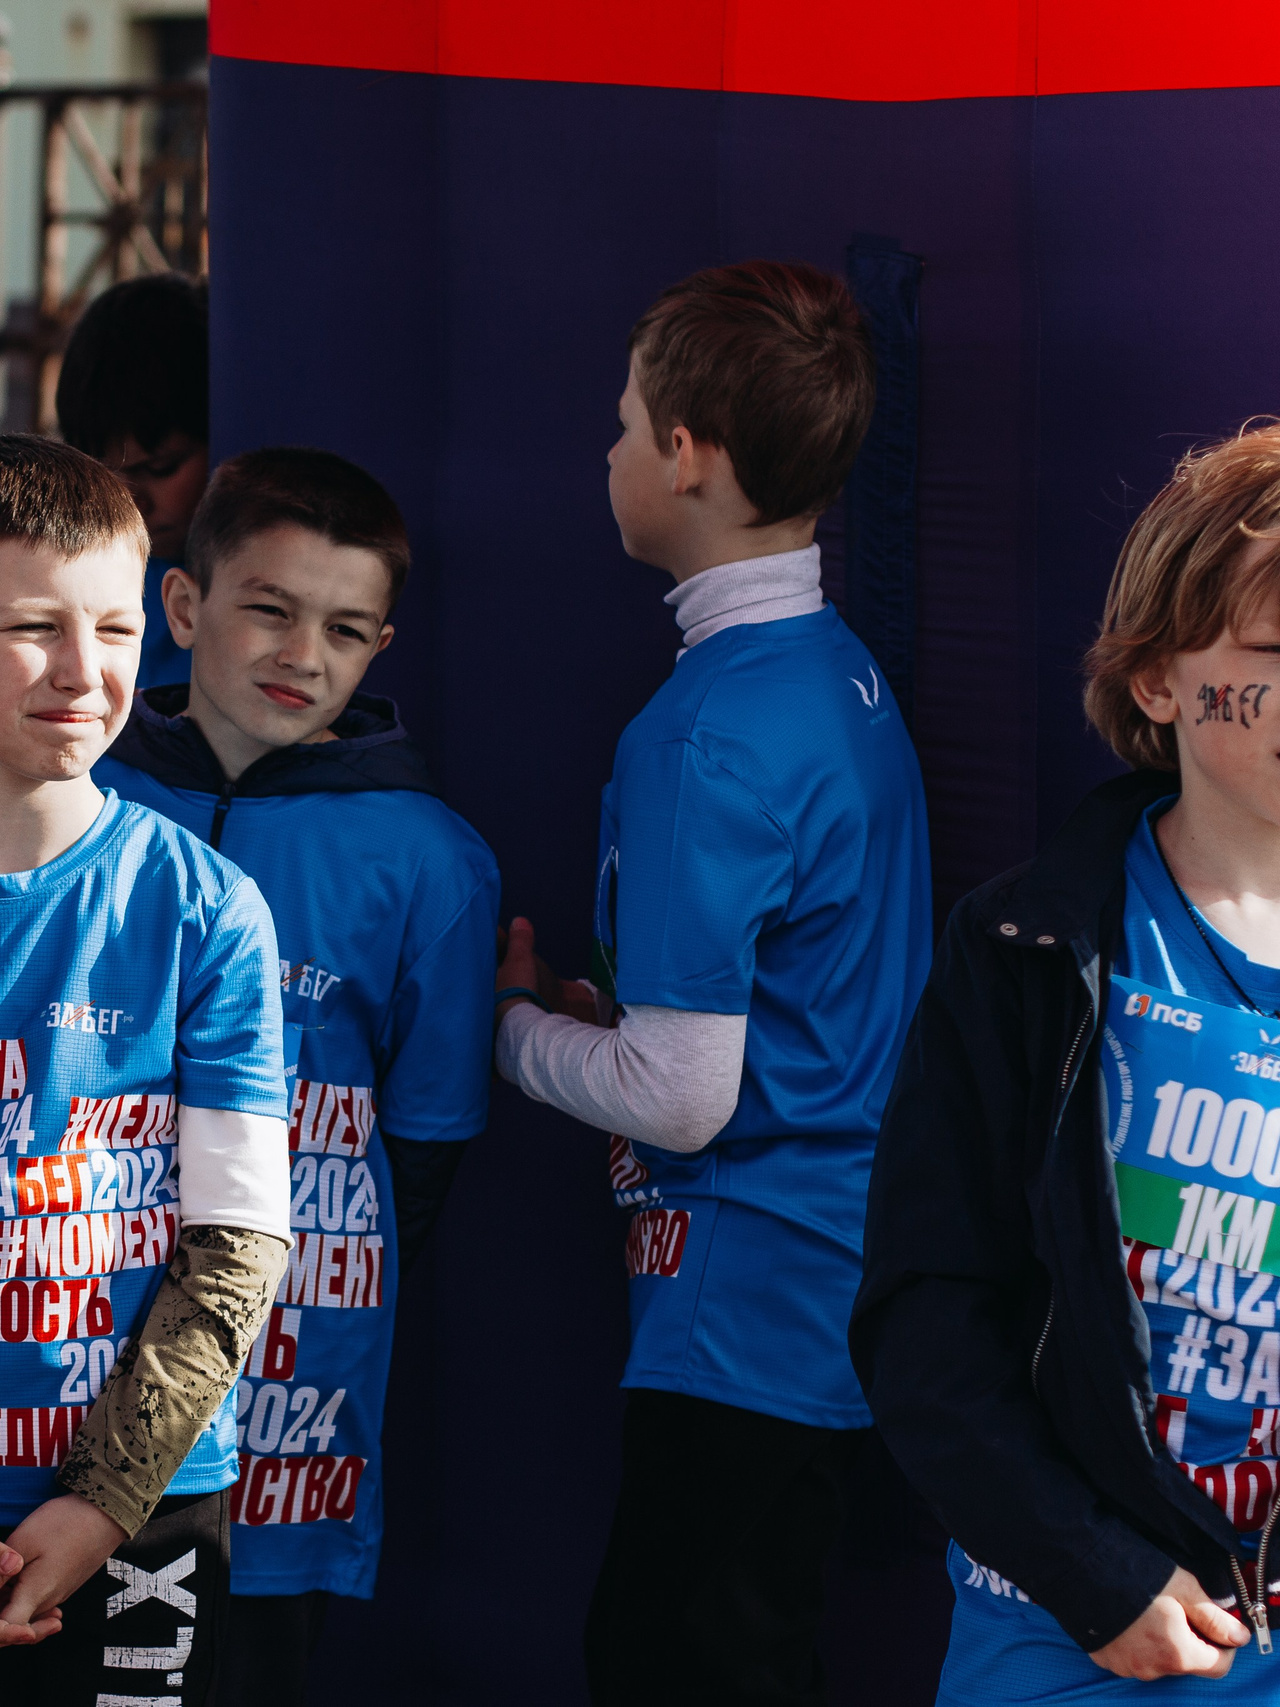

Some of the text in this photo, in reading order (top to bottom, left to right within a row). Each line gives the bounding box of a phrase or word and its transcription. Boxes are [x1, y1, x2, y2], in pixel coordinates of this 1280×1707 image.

[1151, 1001, 1203, 1033] ПСБ
[58, 1095, 179, 1152] #ЦЕЛЬ
[1171, 1182, 1277, 1273] 1КМ
[59, 1338, 130, 1403] 20
